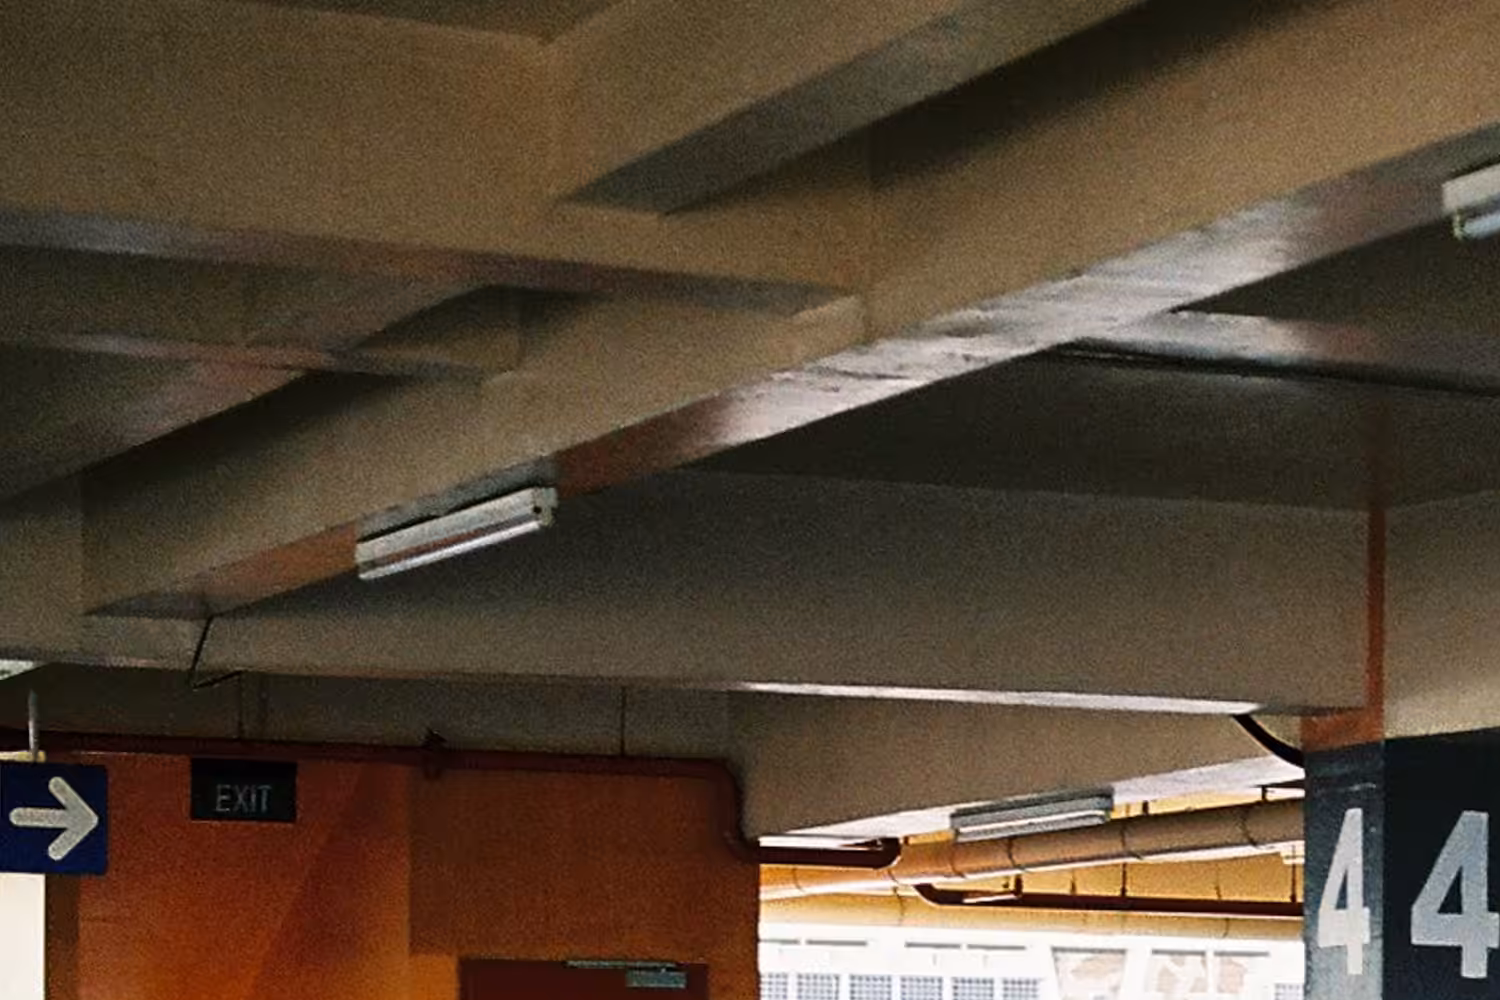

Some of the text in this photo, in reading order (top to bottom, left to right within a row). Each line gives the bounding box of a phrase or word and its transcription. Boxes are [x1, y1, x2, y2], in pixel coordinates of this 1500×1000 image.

[215, 784, 272, 813] EXIT
[1317, 808, 1370, 975] 4
[1411, 810, 1500, 978] 4
